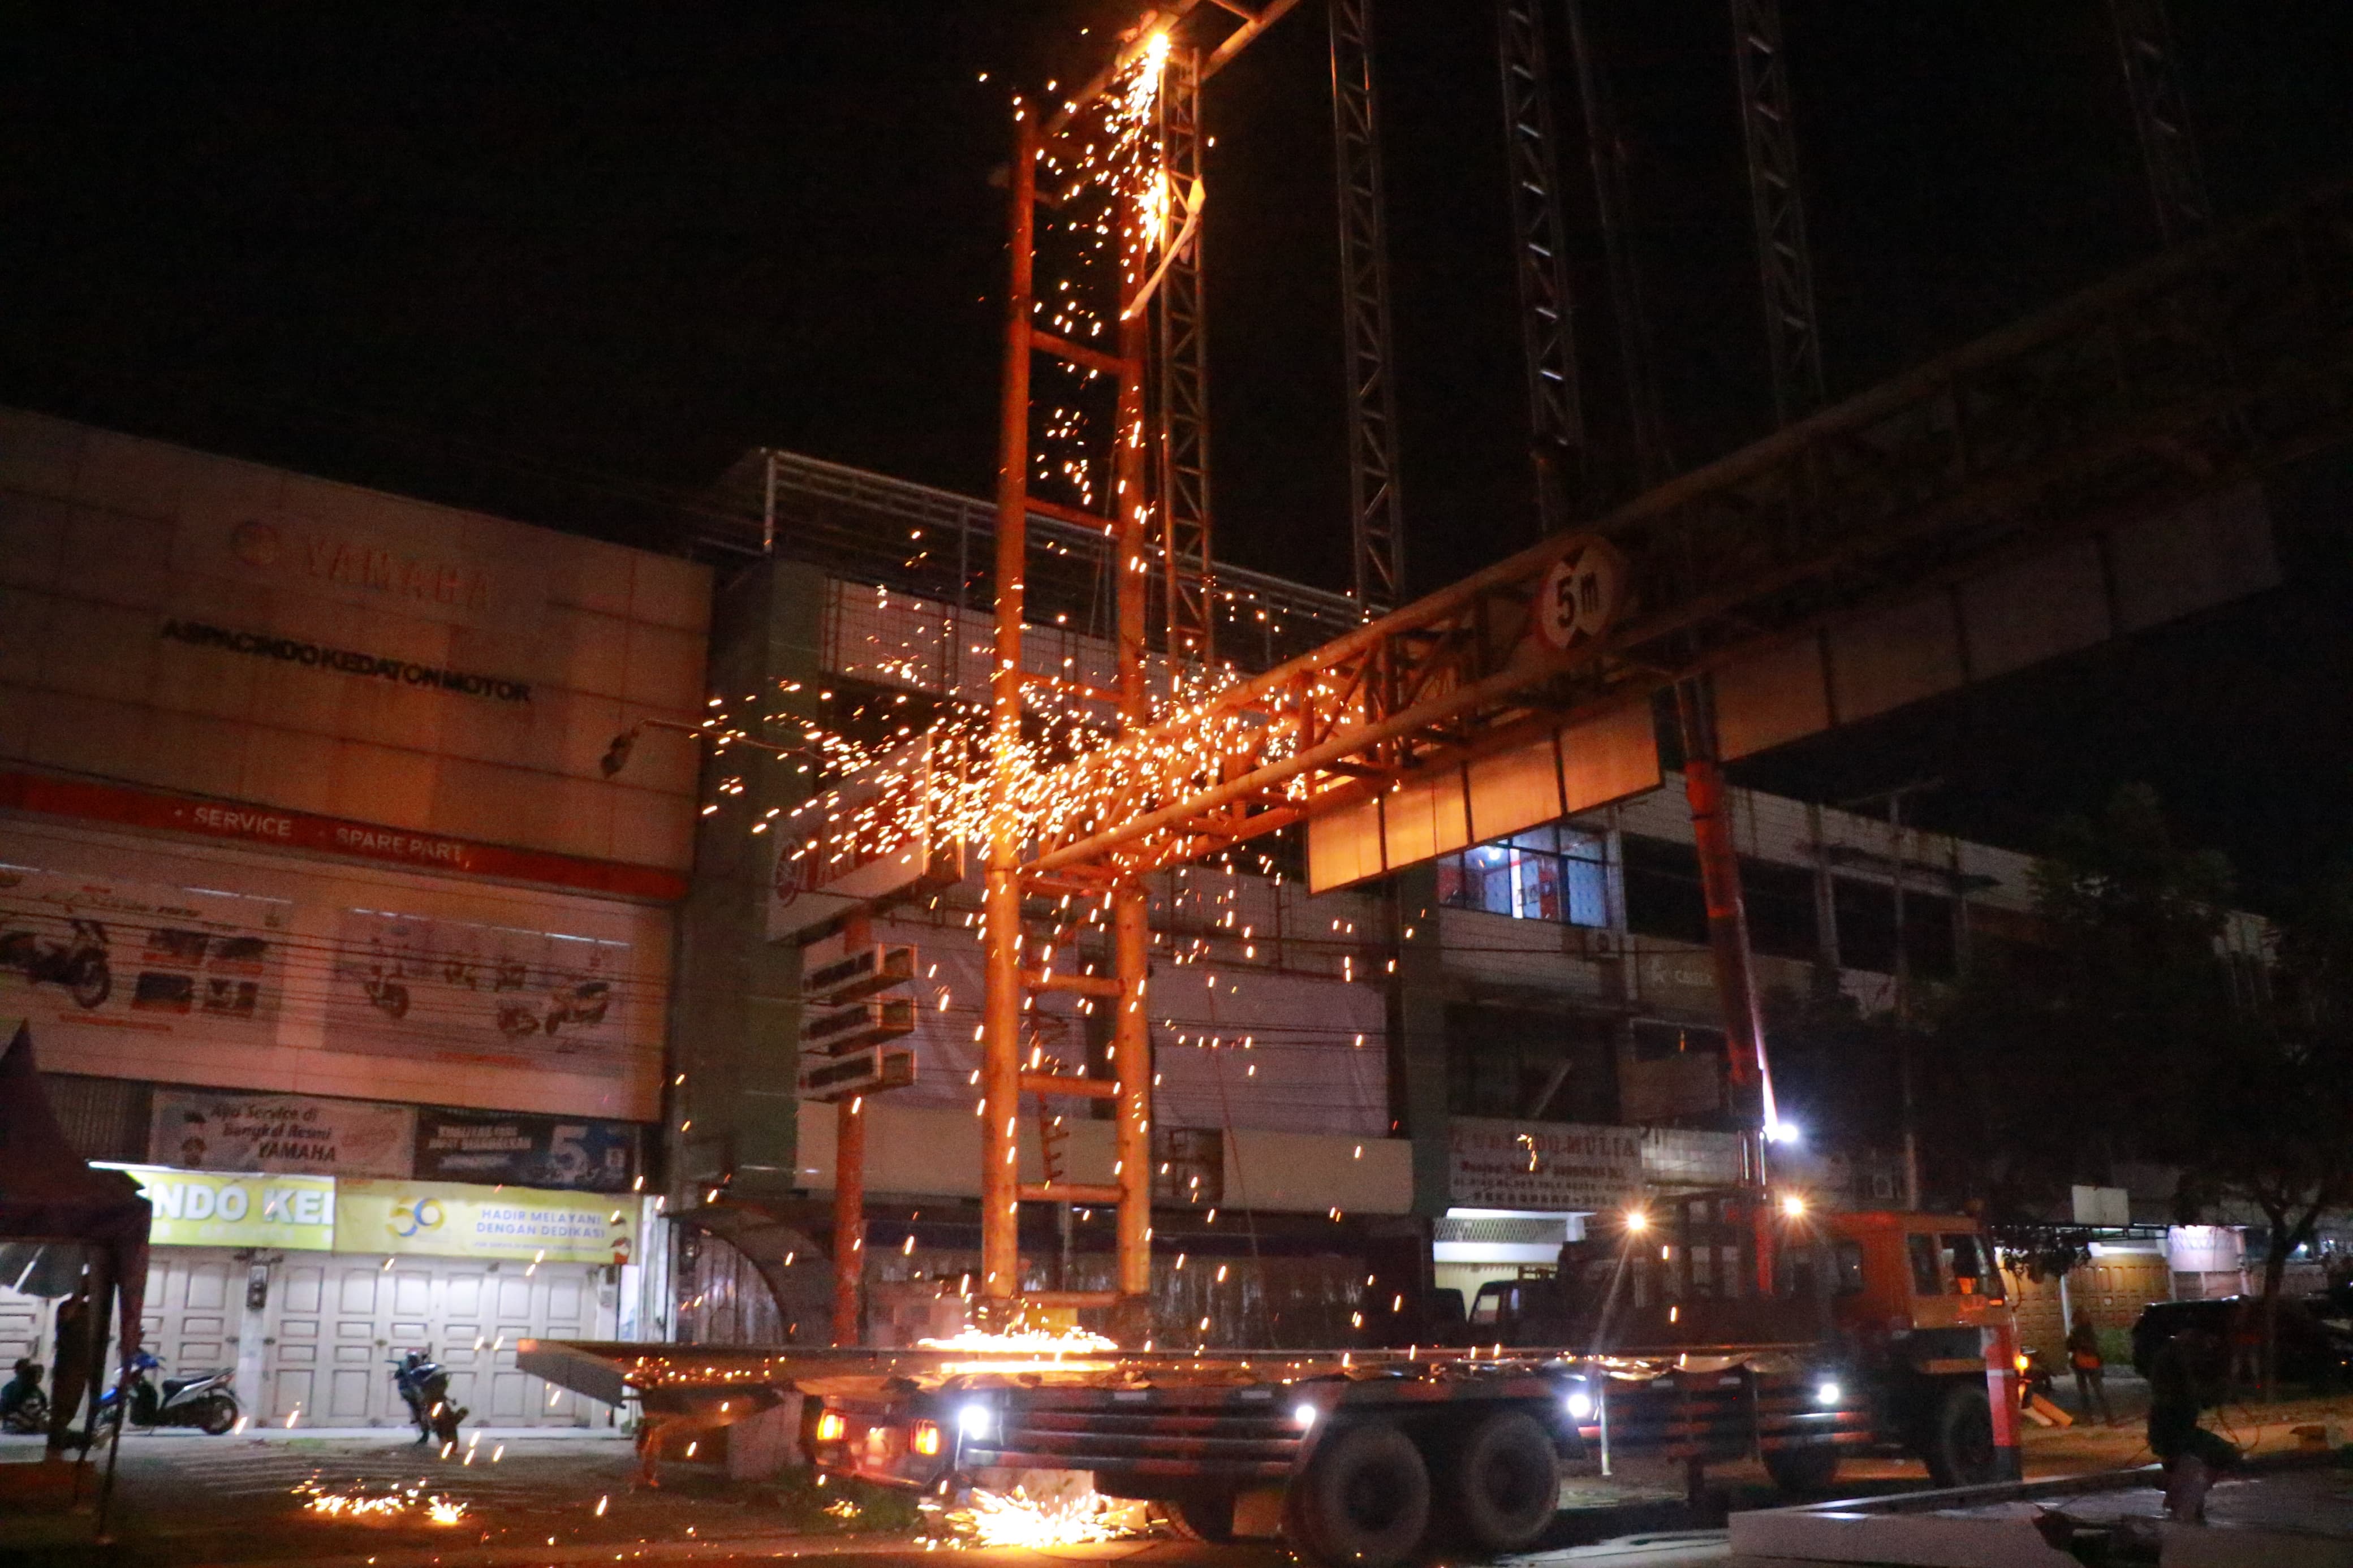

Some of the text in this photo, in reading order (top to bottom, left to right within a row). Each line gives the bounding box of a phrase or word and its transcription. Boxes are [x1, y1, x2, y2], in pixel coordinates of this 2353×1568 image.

[321, 649, 441, 688] KEDATON
[443, 671, 532, 703] MOTOR
[193, 806, 292, 837] SERVICE
[336, 828, 465, 862] SPARE PART
[258, 1141, 336, 1162] YAMAHA
[476, 1221, 606, 1239] DENGAN DEDIKASI
[481, 1209, 602, 1225] HADIR MELAYANI
